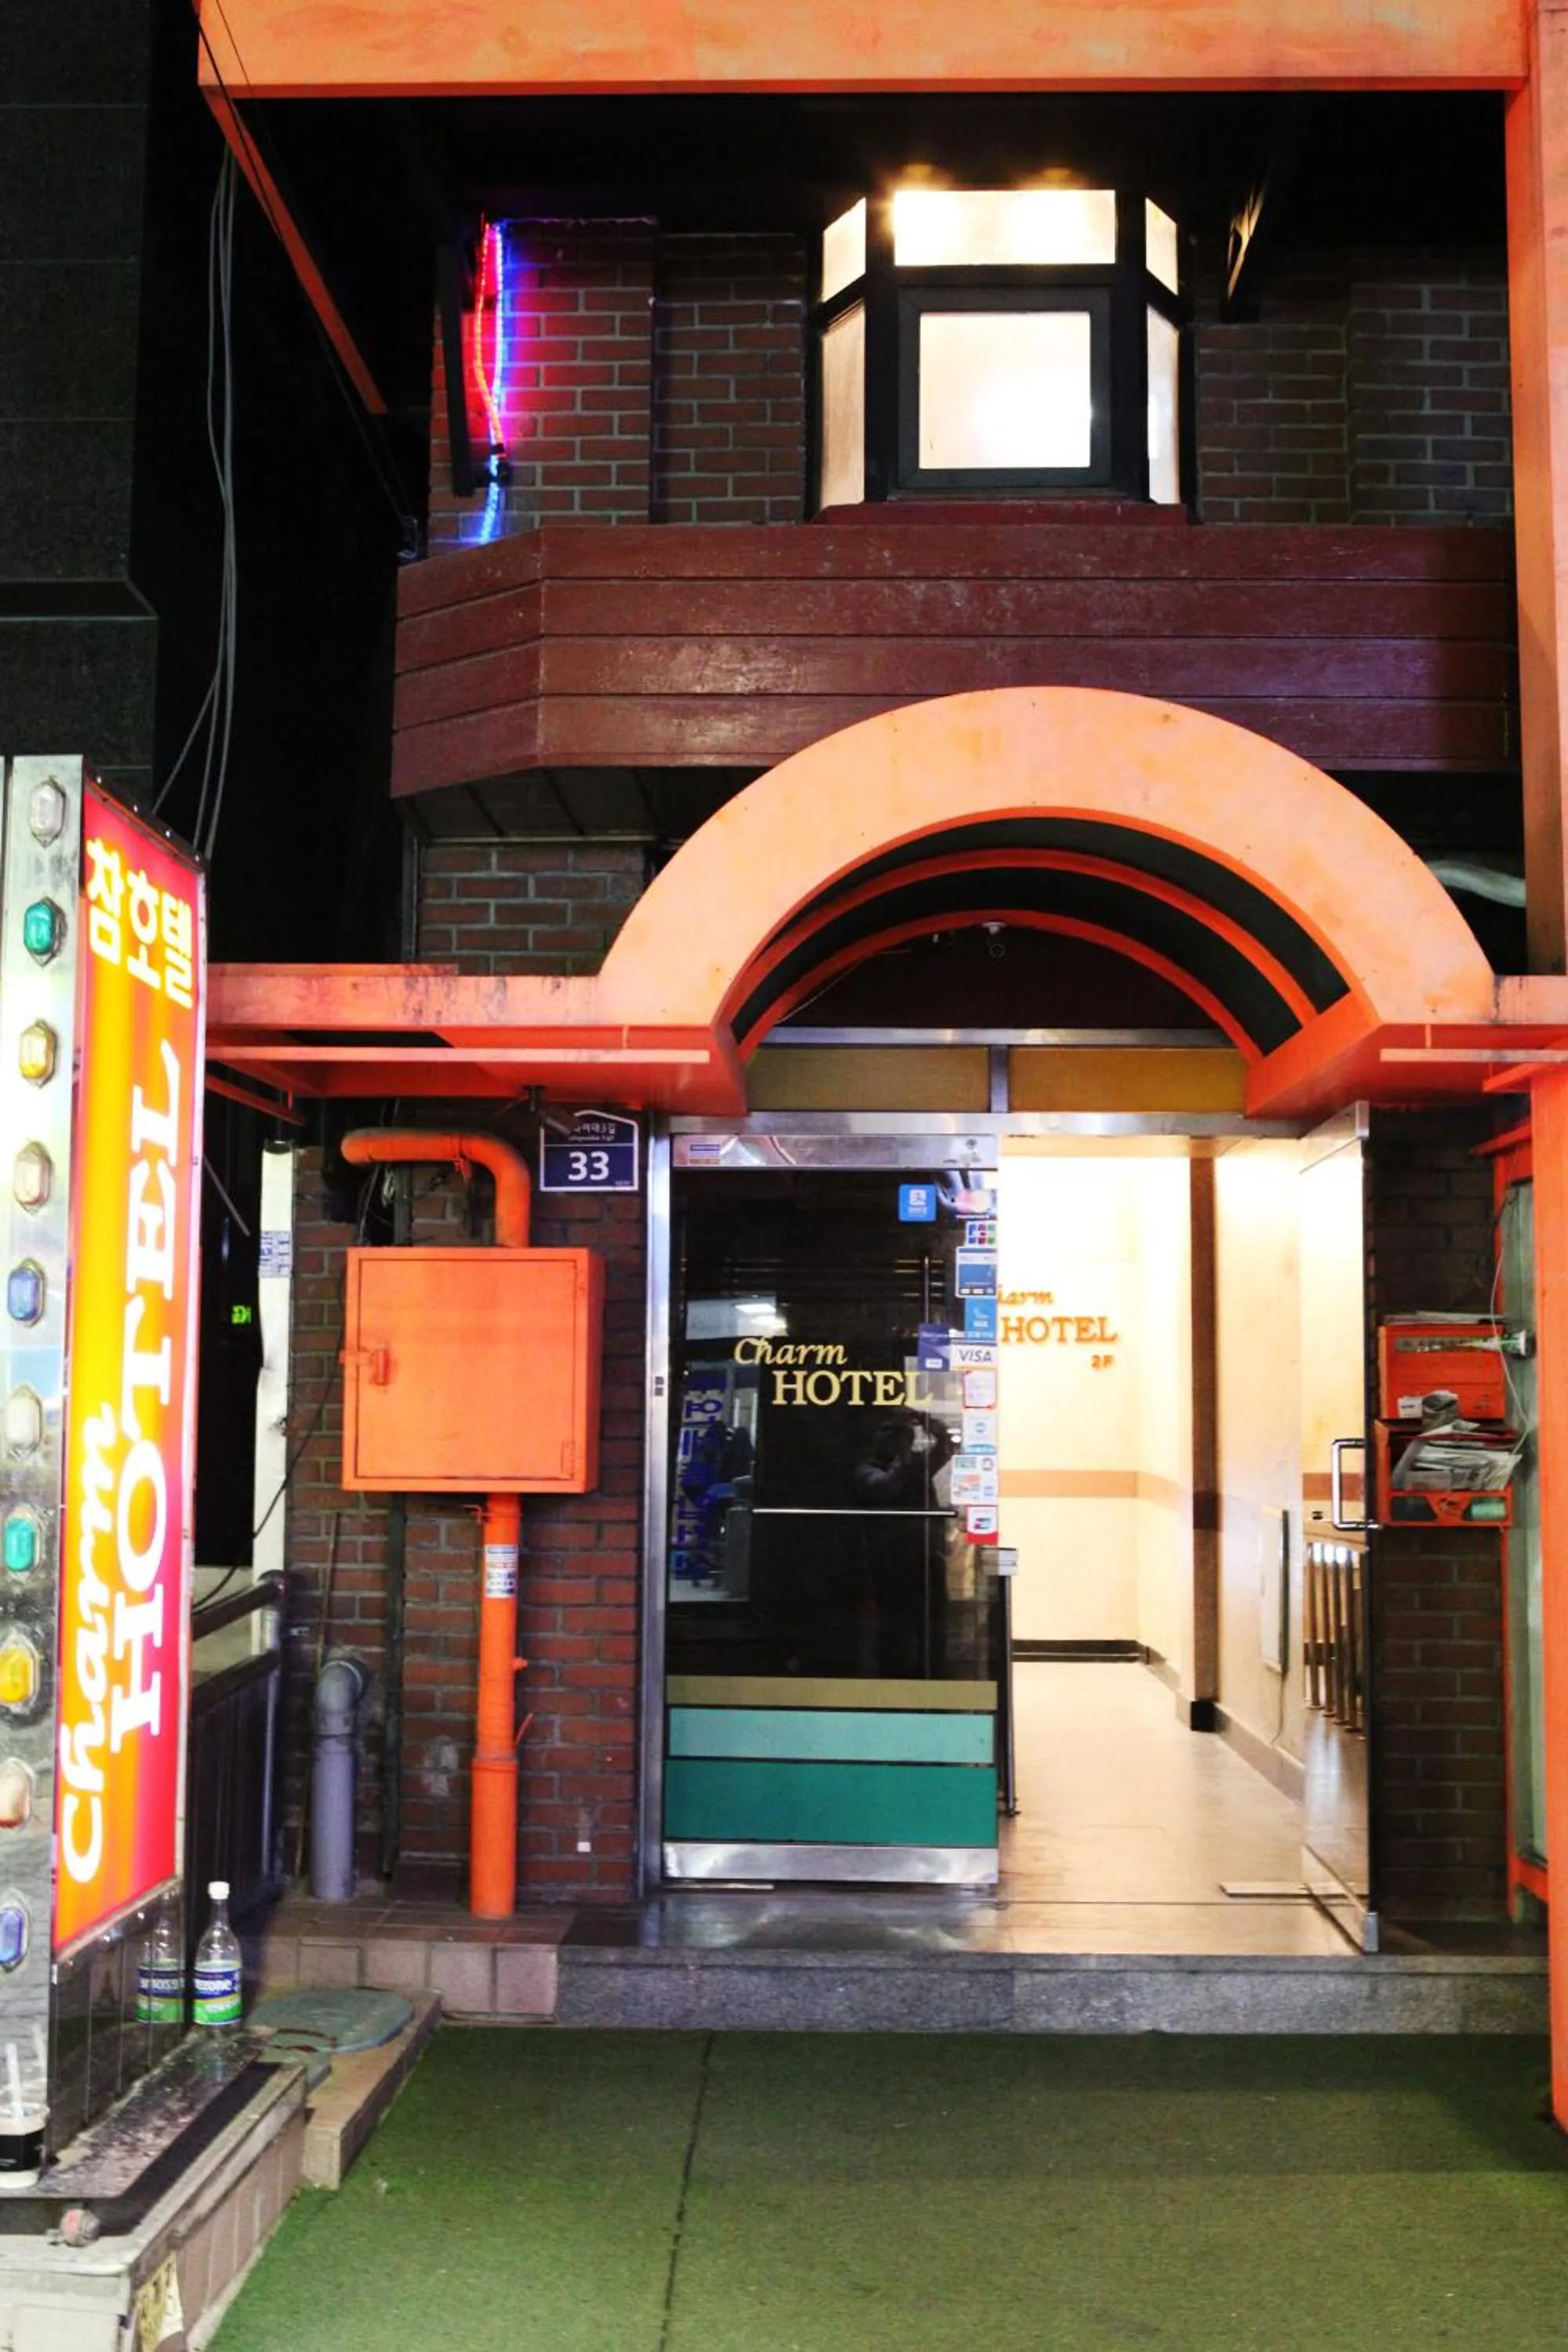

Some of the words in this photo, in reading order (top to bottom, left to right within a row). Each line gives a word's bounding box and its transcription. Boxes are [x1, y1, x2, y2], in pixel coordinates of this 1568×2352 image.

[568, 1151, 609, 1181] 33
[1001, 1316, 1118, 1343] HOTEL
[734, 1336, 848, 1366] Charm
[959, 1349, 992, 1363] VISA
[112, 1038, 180, 1754] HOTEL
[771, 1370, 935, 1406] HOTEL
